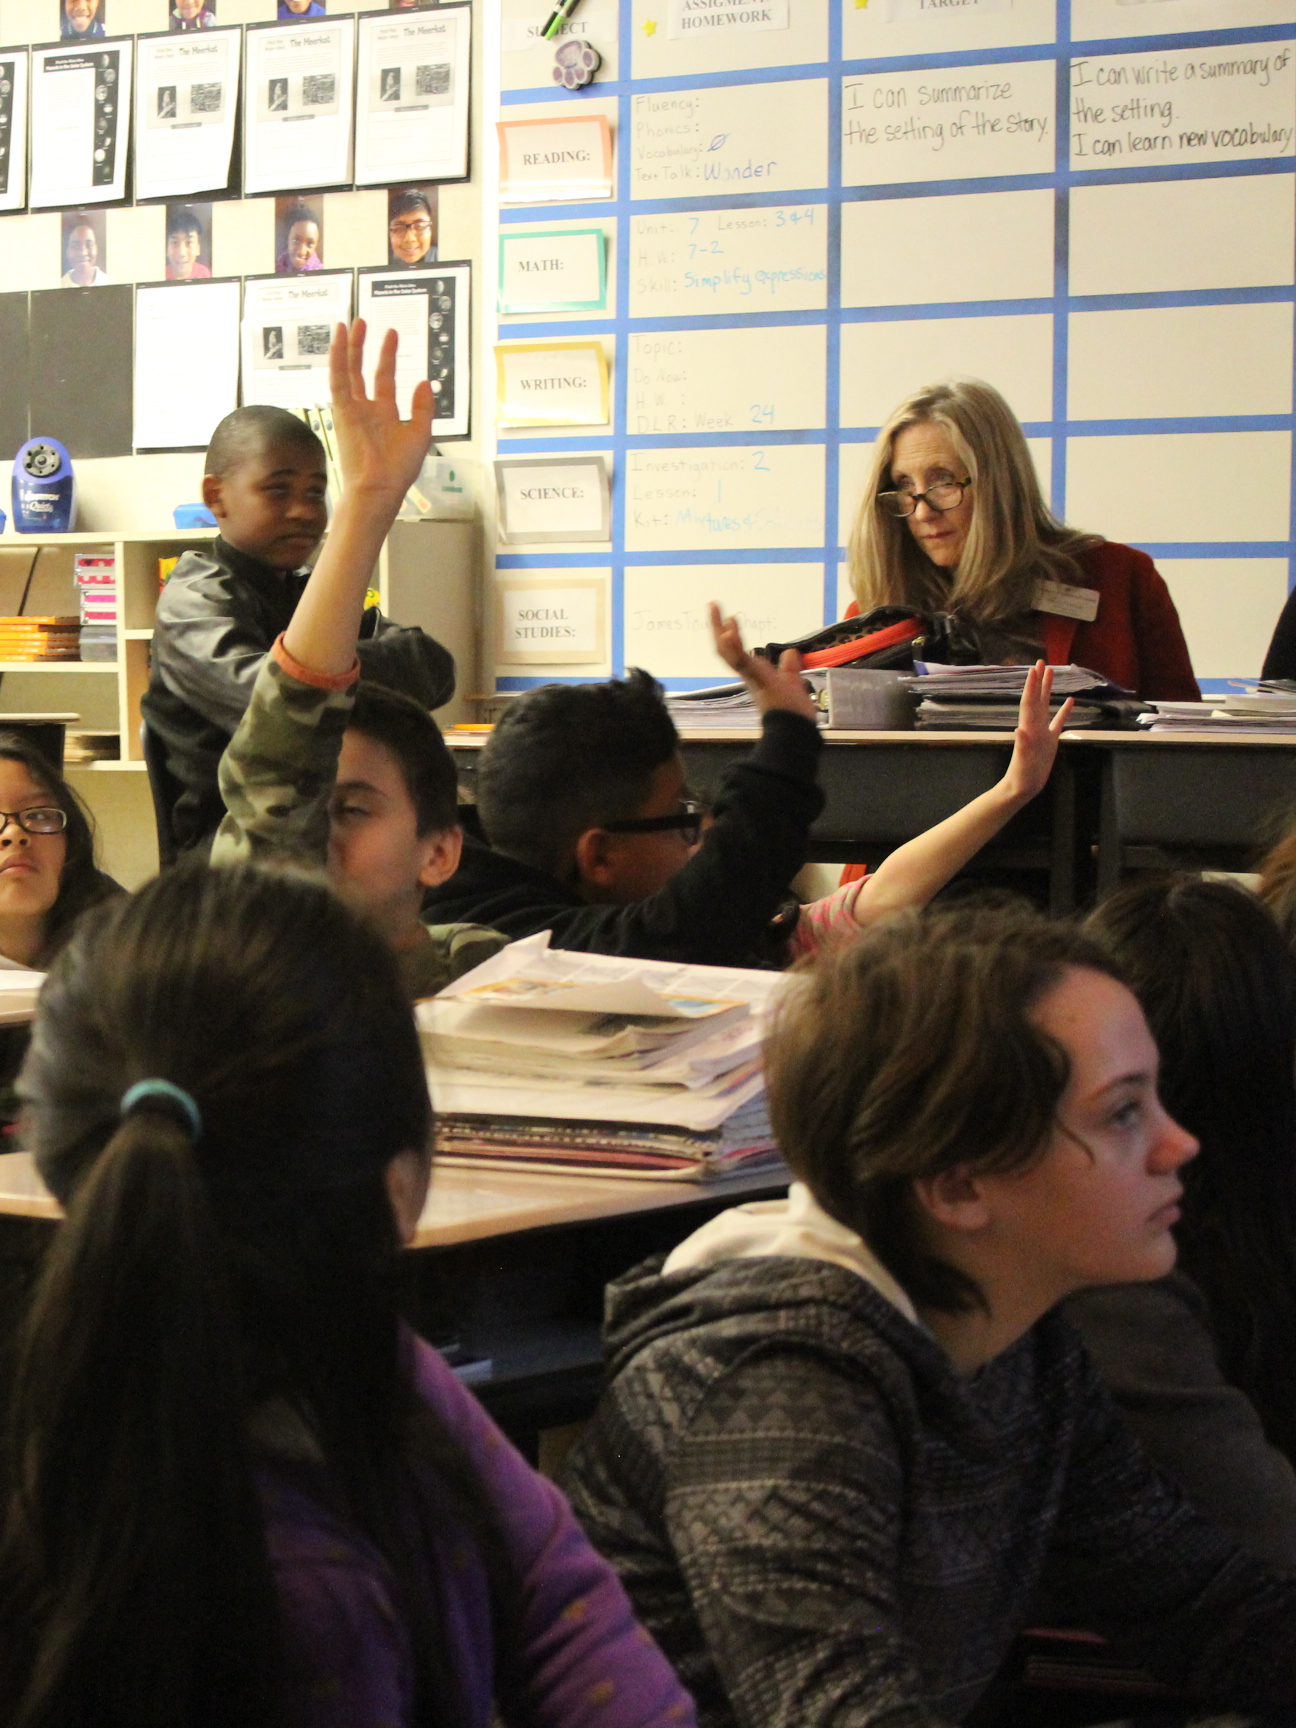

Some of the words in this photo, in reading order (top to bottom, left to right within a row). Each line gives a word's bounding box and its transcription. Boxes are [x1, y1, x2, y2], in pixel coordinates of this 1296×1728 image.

[682, 9, 771, 29] HOMEWORK
[1071, 61, 1092, 87] I
[1097, 66, 1129, 86] can
[1132, 60, 1179, 85] write
[1185, 63, 1196, 80] a
[1200, 57, 1270, 87] summary
[1274, 48, 1292, 71] of
[636, 96, 700, 118] Fluency:
[844, 83, 865, 110] I
[873, 87, 907, 109] can
[1072, 97, 1106, 124] the
[1111, 98, 1181, 128] setting.
[637, 122, 700, 139] Phonics:
[844, 119, 879, 145] the
[885, 117, 945, 152] setting
[950, 110, 971, 138] of
[971, 111, 1003, 136] the
[1072, 133, 1089, 156] I
[1092, 137, 1123, 157] can
[1128, 131, 1173, 152] learn
[1179, 130, 1208, 150] new
[1211, 122, 1294, 153] vocabulary
[523, 150, 590, 166] READING:
[688, 217, 700, 235] 7
[518, 259, 564, 272] MATH:
[684, 267, 752, 296] Simplify
[632, 334, 682, 362] Topic:
[520, 376, 587, 391] WRITING:
[694, 410, 734, 430] Week
[749, 403, 776, 425] 24
[752, 450, 771, 472] 2
[520, 487, 584, 500] SCIENCE:
[518, 609, 568, 621] SOCIAL
[515, 626, 576, 638] STUDIES:
